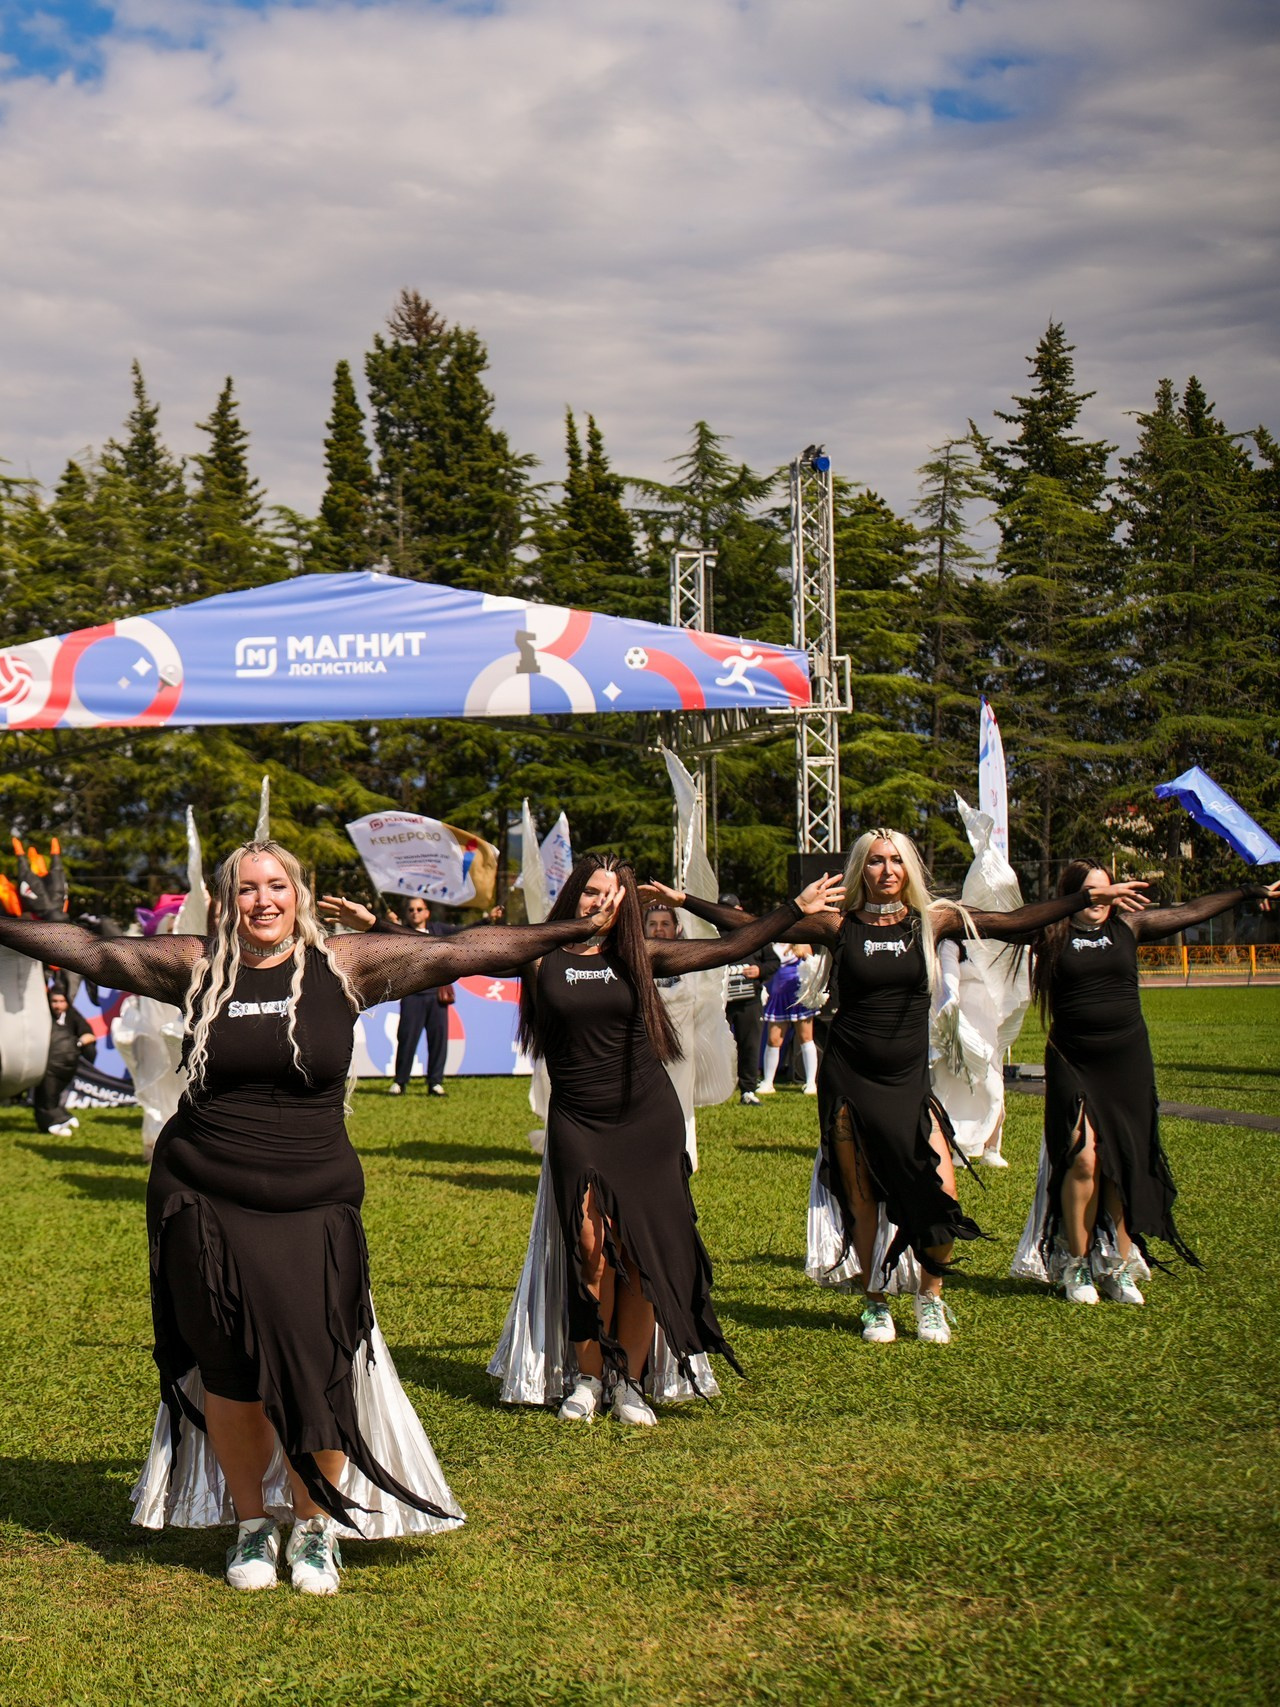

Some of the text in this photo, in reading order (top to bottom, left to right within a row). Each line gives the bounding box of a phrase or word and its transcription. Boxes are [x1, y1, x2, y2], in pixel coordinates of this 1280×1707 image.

[287, 631, 427, 661] МАГНИТ
[288, 660, 388, 677] ЛОГИСТИКА
[370, 831, 442, 846] КЕМЕРОВО
[565, 966, 618, 986] SIBERIA
